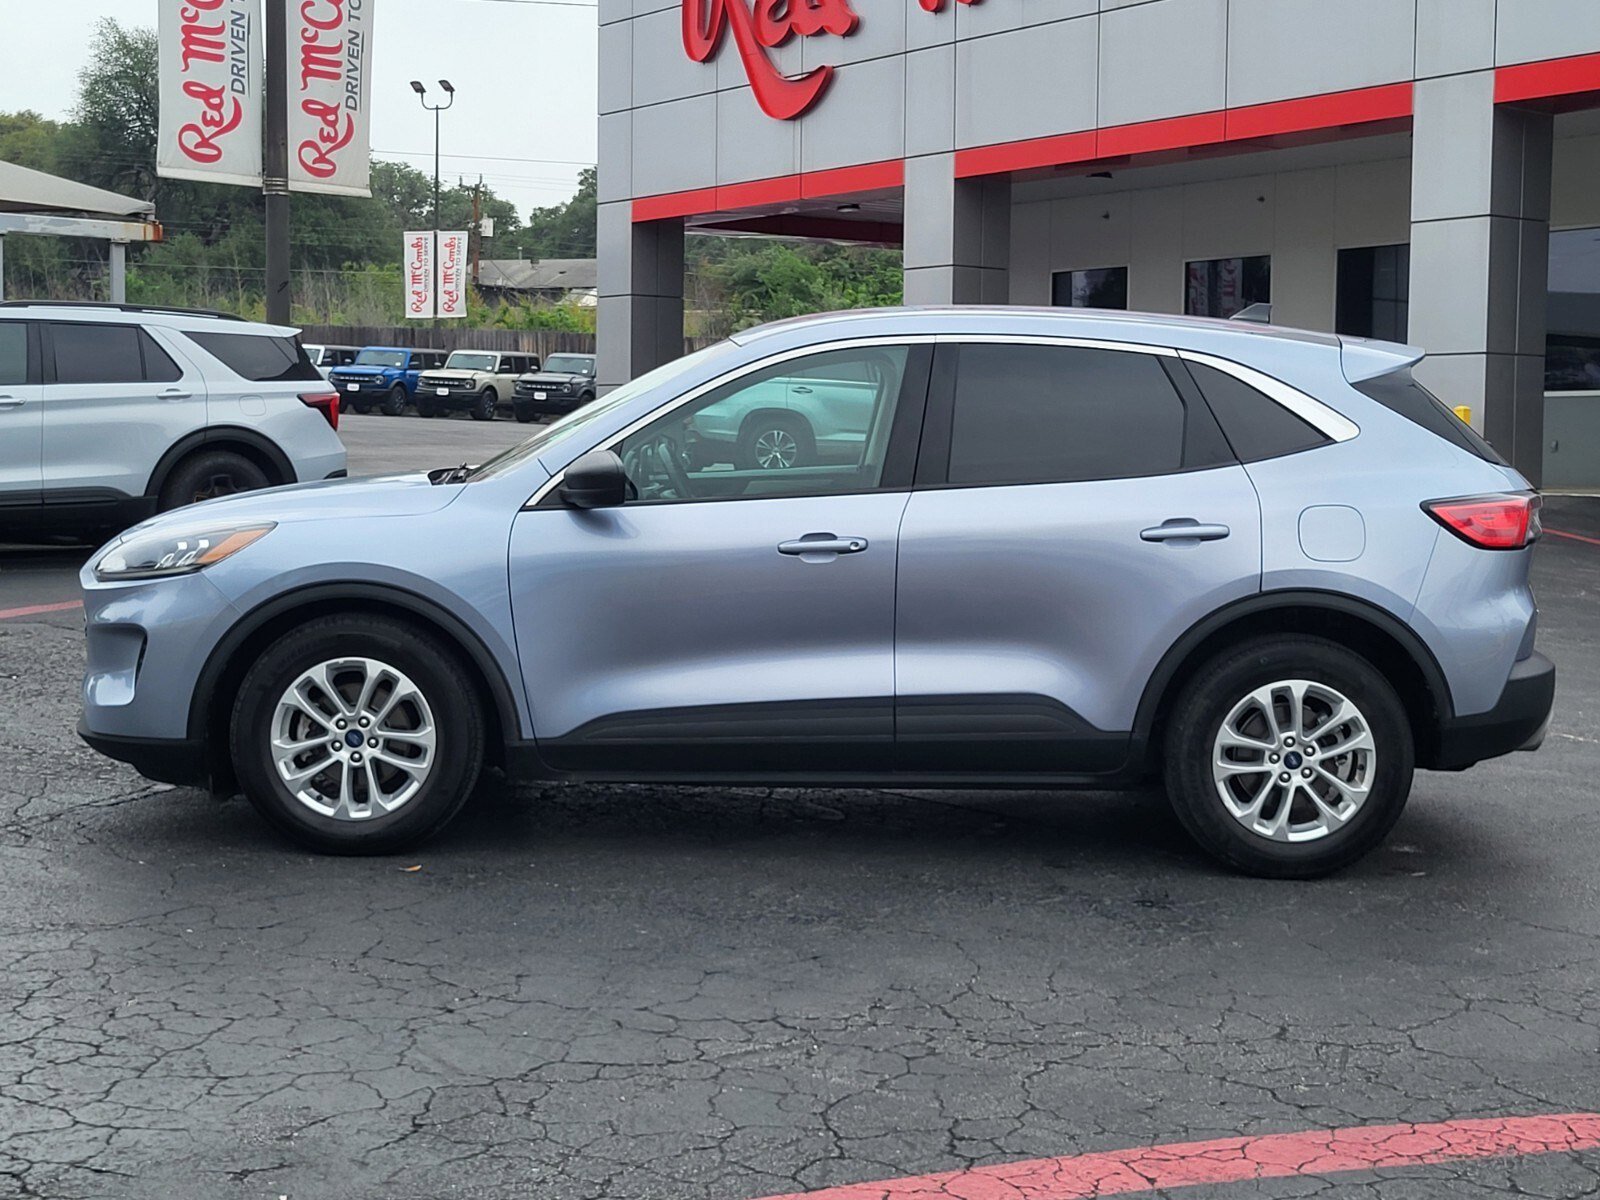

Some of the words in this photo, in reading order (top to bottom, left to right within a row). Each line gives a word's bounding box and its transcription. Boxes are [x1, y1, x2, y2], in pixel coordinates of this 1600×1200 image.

[231, 10, 246, 95] DRIVEN
[345, 30, 361, 112] DRIVEN
[178, 80, 242, 164] Red
[298, 98, 355, 178] Red
[411, 237, 423, 287] McCombs
[443, 237, 456, 287] McCombs
[411, 290, 427, 312] Red
[443, 290, 459, 312] Red
